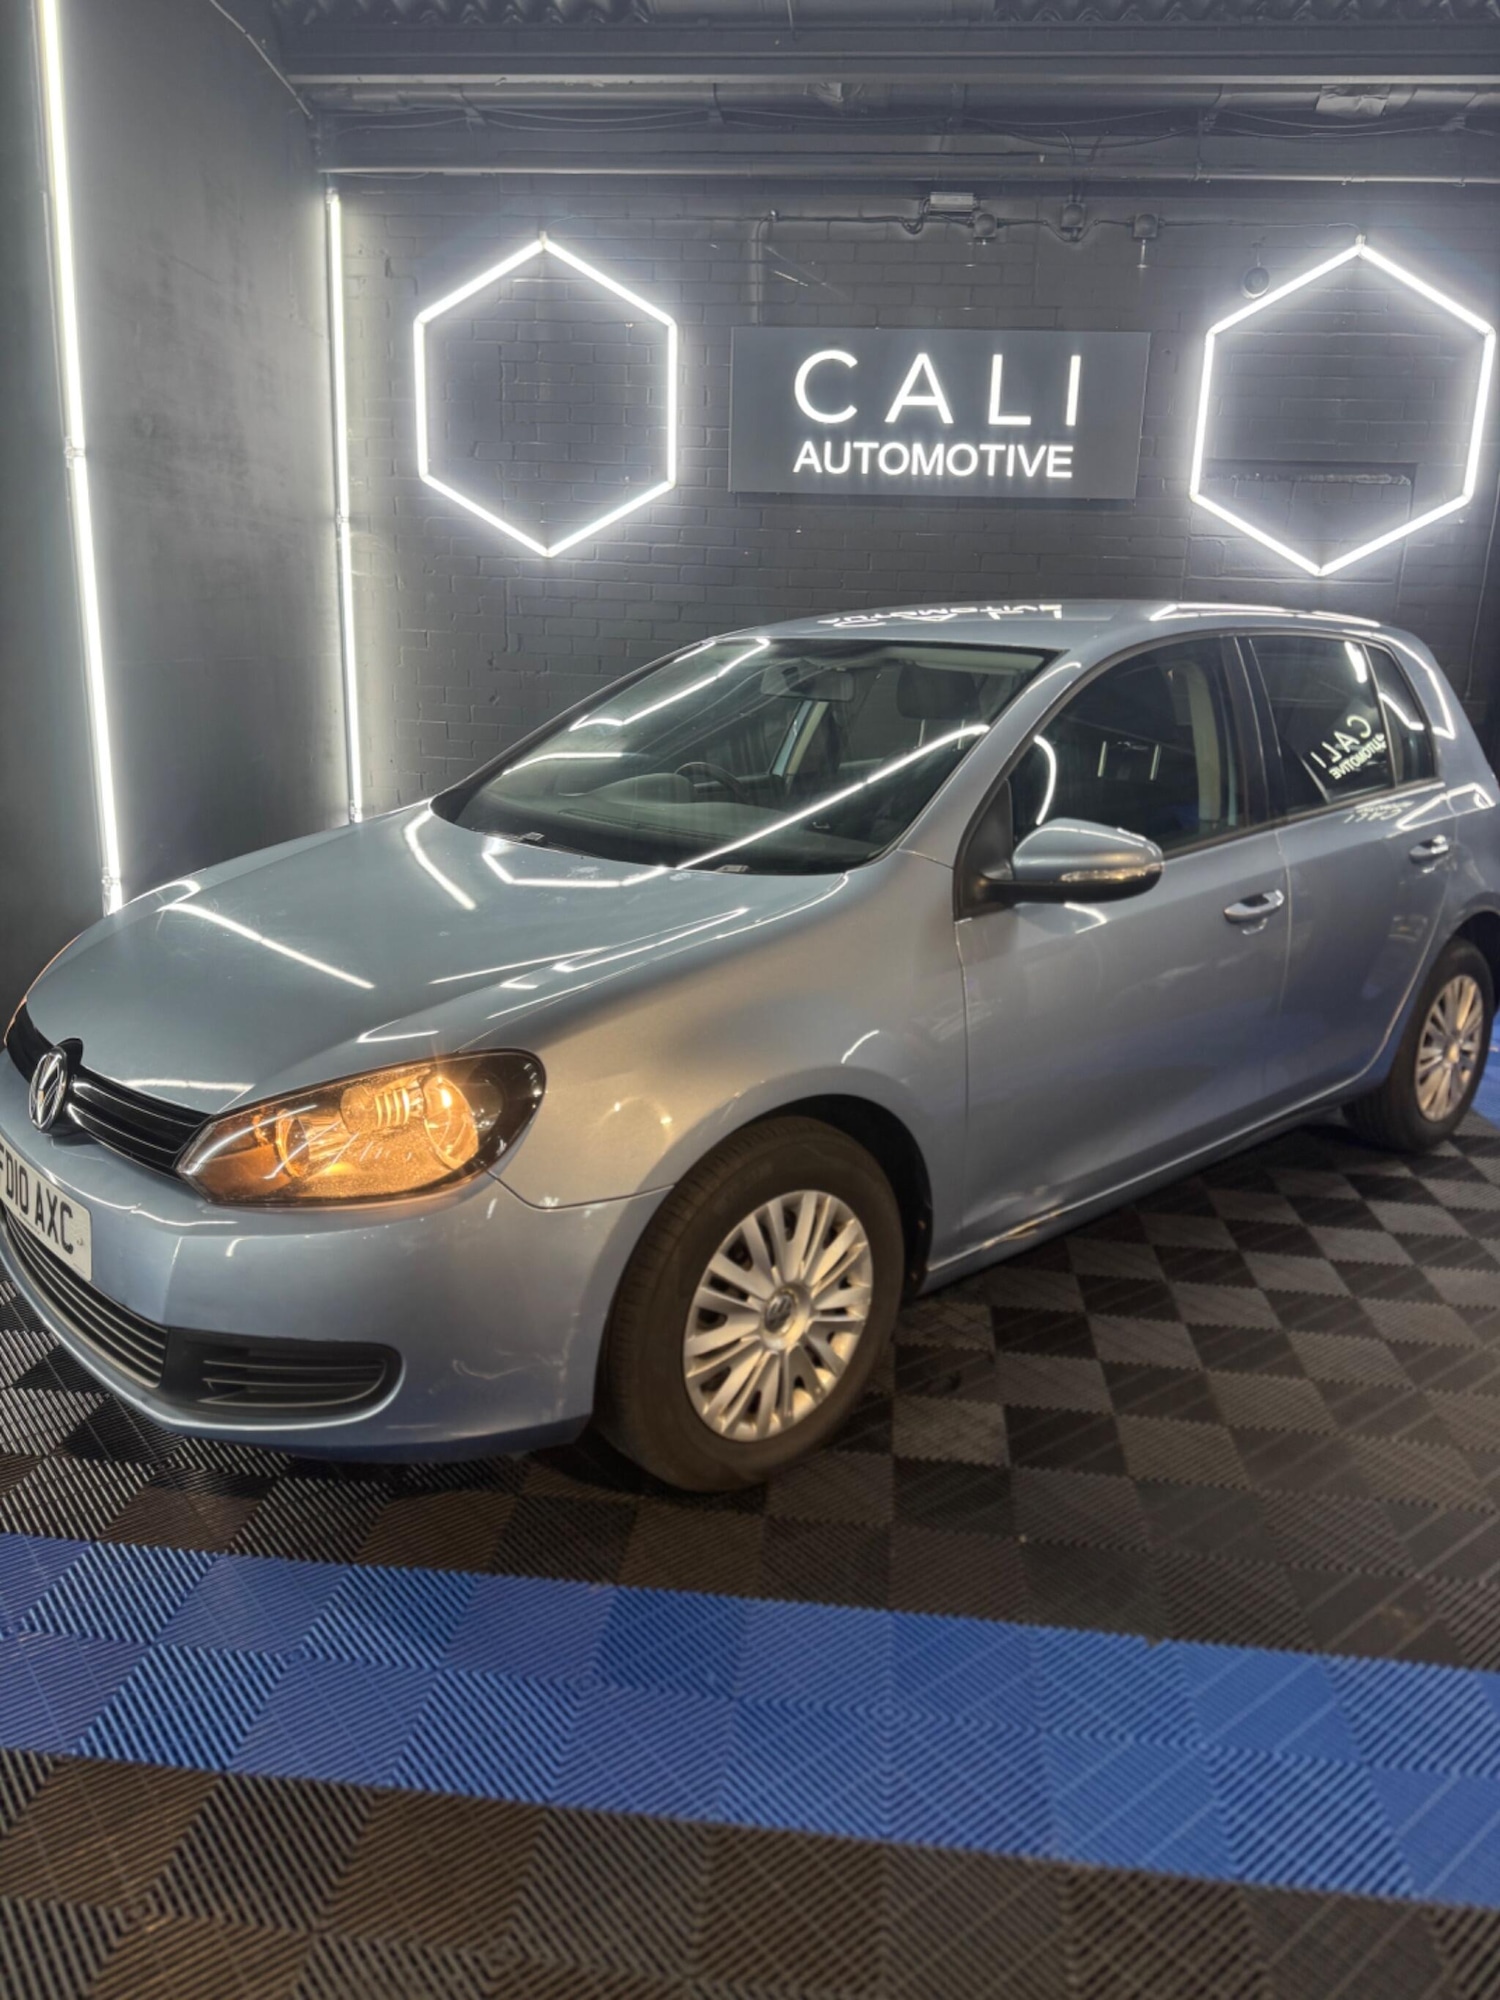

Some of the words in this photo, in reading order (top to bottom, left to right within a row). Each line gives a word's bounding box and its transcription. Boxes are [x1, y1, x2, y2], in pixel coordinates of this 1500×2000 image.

[794, 350, 1081, 426] CALI
[793, 441, 1074, 478] AUTOMOTIVE
[35, 1181, 73, 1254] AXC
